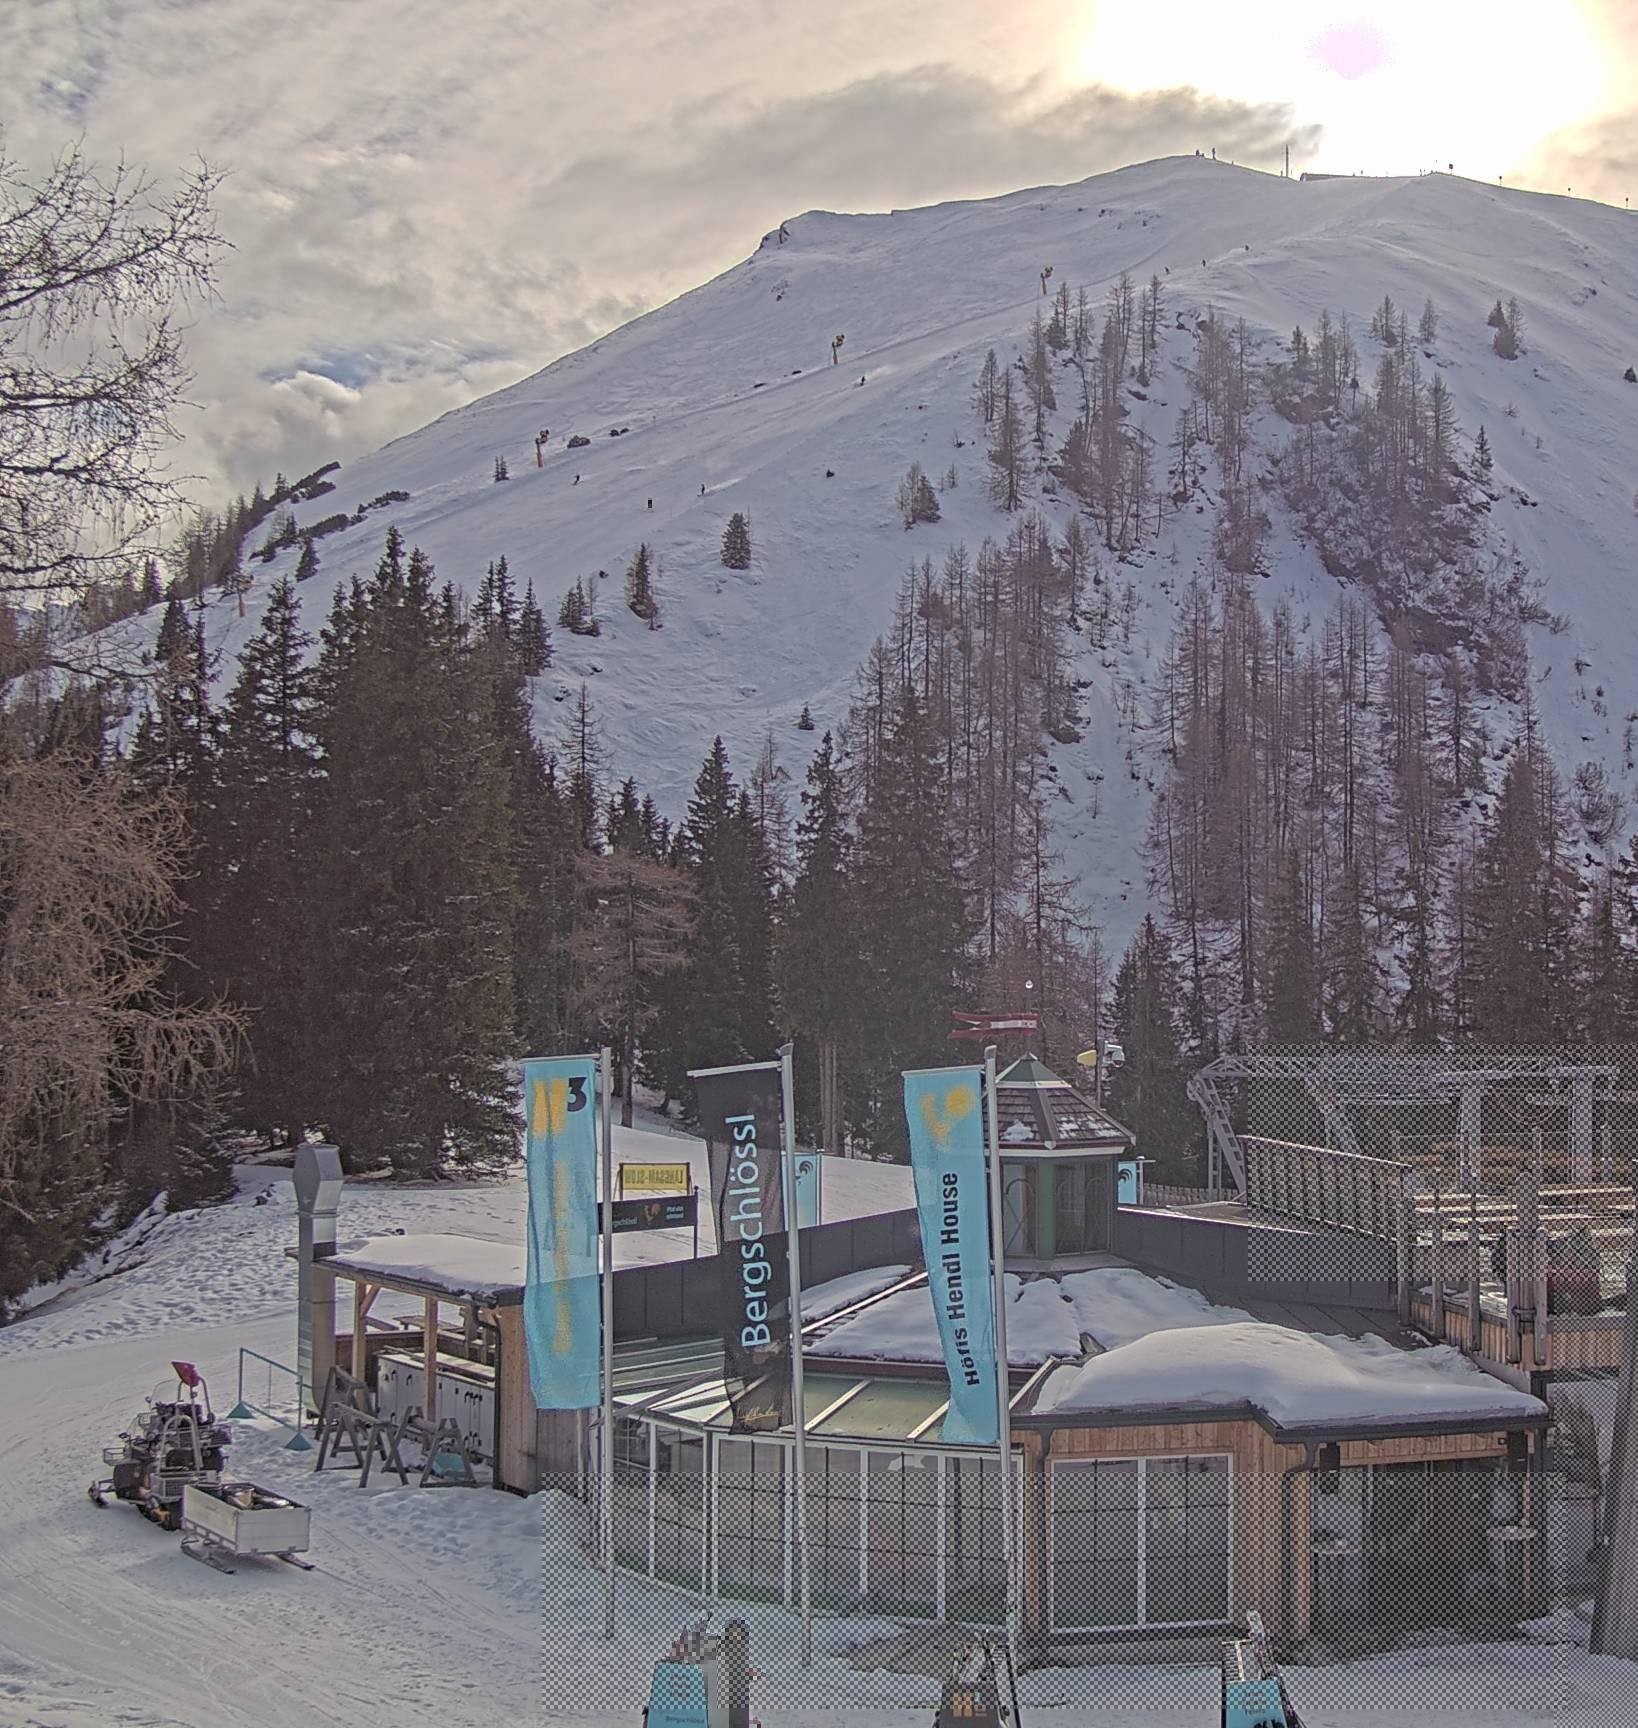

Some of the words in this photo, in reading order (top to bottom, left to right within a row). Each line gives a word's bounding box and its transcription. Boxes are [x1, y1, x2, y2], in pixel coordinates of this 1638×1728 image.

[725, 1114, 772, 1348] Bergschlössl
[941, 1172, 961, 1245] House
[942, 1253, 966, 1320] Hendl
[955, 1327, 980, 1386] Höfis
